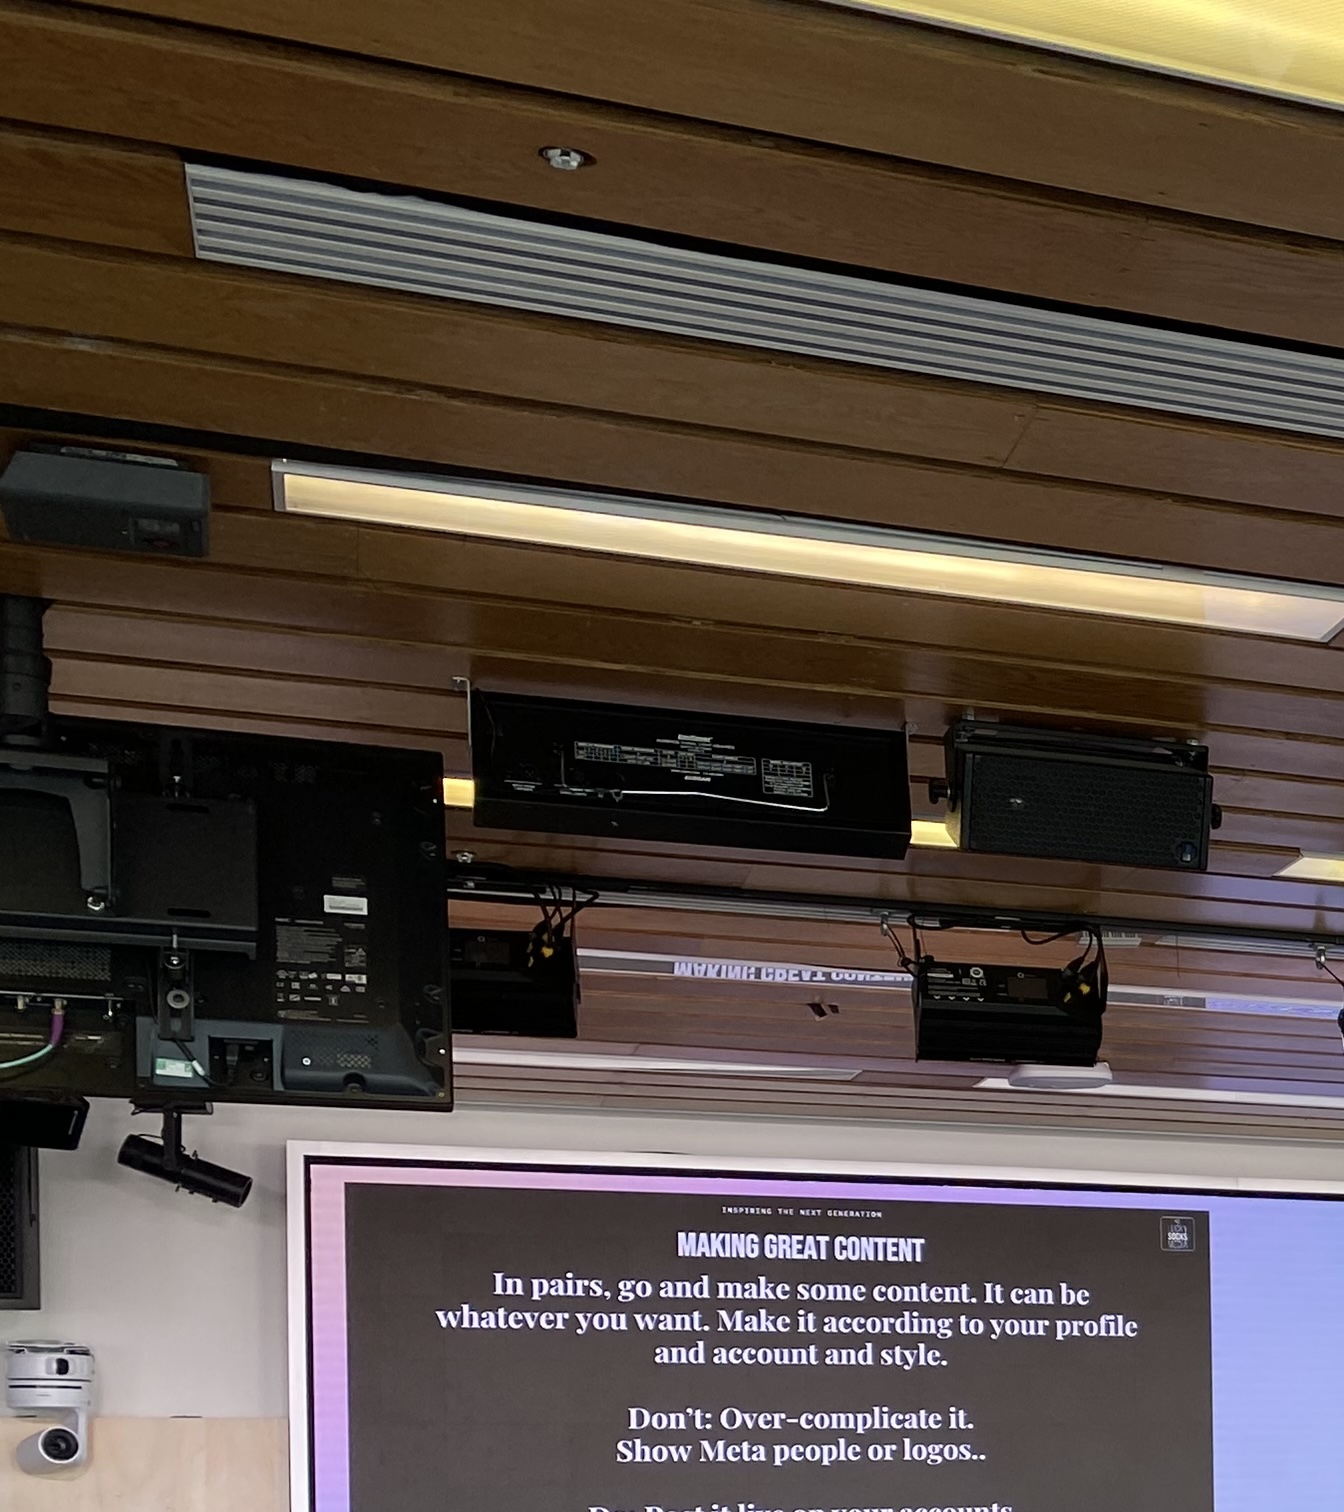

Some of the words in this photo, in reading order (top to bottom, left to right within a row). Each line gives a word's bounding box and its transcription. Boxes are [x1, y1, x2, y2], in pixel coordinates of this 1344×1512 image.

[722, 1206, 772, 1215] INSPIRING
[777, 1208, 794, 1216] THE
[799, 1209, 822, 1217] NEXT
[827, 1209, 882, 1218] GENERATION
[677, 1231, 760, 1259] MAKING
[763, 1233, 830, 1261] GREAT
[834, 1235, 926, 1263] CONTENT
[492, 1272, 525, 1296] In
[530, 1272, 612, 1301] pairs,
[617, 1279, 653, 1303] go
[659, 1274, 711, 1299] and
[716, 1275, 791, 1300] make
[796, 1283, 867, 1302] some
[872, 1282, 978, 1304] content.
[983, 1282, 1005, 1304] It
[1010, 1287, 1055, 1305] can
[1059, 1282, 1090, 1306] be
[435, 1303, 570, 1330] whatever
[574, 1312, 629, 1335] you
[632, 1310, 711, 1332] want.
[716, 1308, 791, 1333] Make
[797, 1309, 818, 1333] it
[823, 1310, 954, 1340] according
[959, 1314, 985, 1336] to
[989, 1318, 1050, 1340] your
[1055, 1314, 1138, 1341] profile
[654, 1340, 706, 1365] and
[712, 1344, 820, 1366] account
[824, 1342, 875, 1366] and
[880, 1342, 948, 1371] style.
[627, 1407, 713, 1430] Don't:
[719, 1406, 943, 1434] Over-complicate
[948, 1406, 974, 1430] it.
[616, 1438, 693, 1463] Show
[699, 1439, 767, 1462] Meta
[772, 1437, 862, 1467] people
[867, 1444, 898, 1461] or
[902, 1437, 987, 1466] logos..
